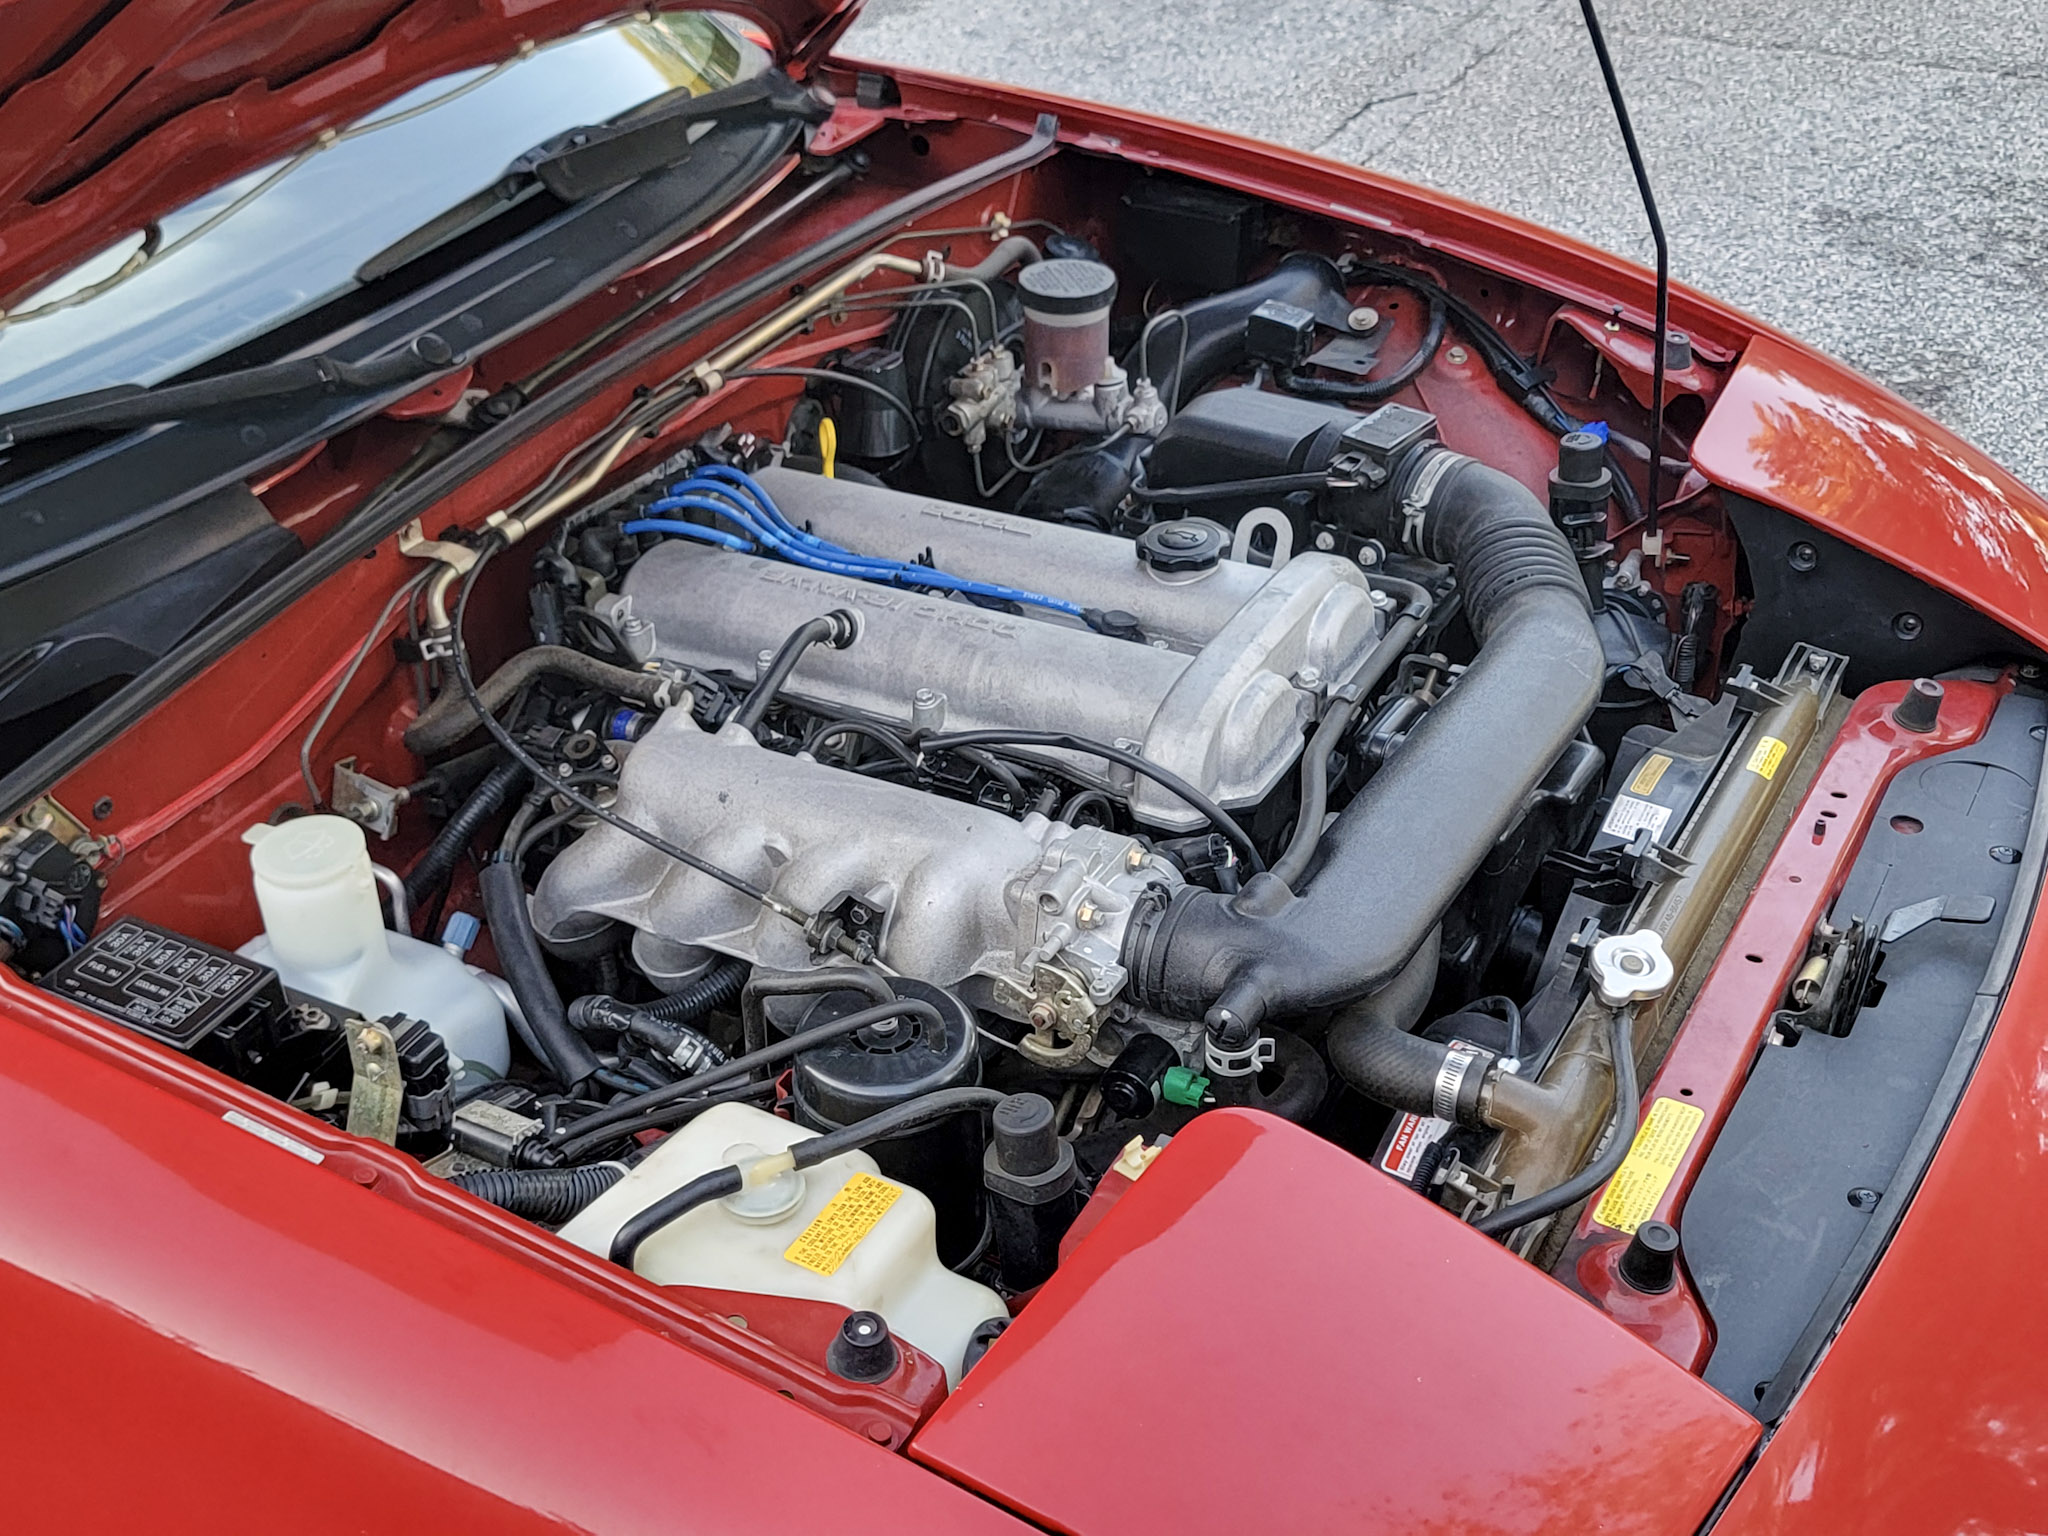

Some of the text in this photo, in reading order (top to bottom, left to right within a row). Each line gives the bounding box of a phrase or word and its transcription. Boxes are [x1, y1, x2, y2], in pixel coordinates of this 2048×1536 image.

[1022, 591, 1043, 601] CABLE
[88, 960, 106, 972] FUEL
[708, 1043, 726, 1063] FUEL
[1396, 1114, 1419, 1152] FAN WAR
[799, 1220, 823, 1242] CAUTION
